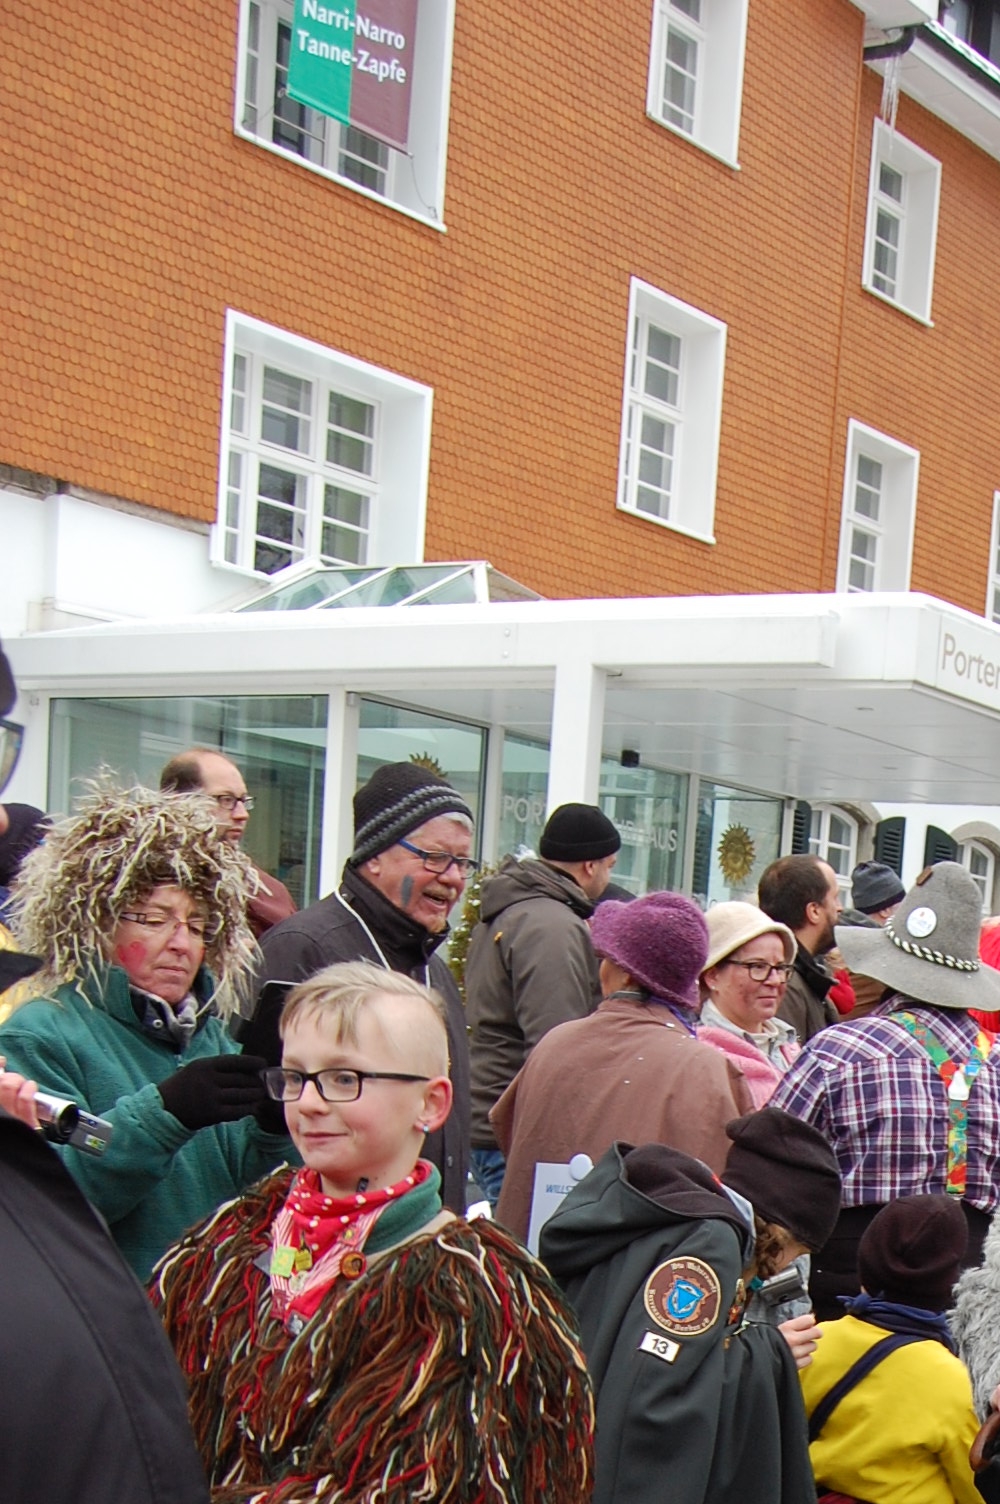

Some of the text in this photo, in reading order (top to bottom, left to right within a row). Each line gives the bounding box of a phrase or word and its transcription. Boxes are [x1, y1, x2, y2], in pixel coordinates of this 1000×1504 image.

[302, 0, 406, 50] Narri-Narro
[297, 29, 407, 83] Tanne-Zapfe
[652, 1338, 669, 1355] 13
